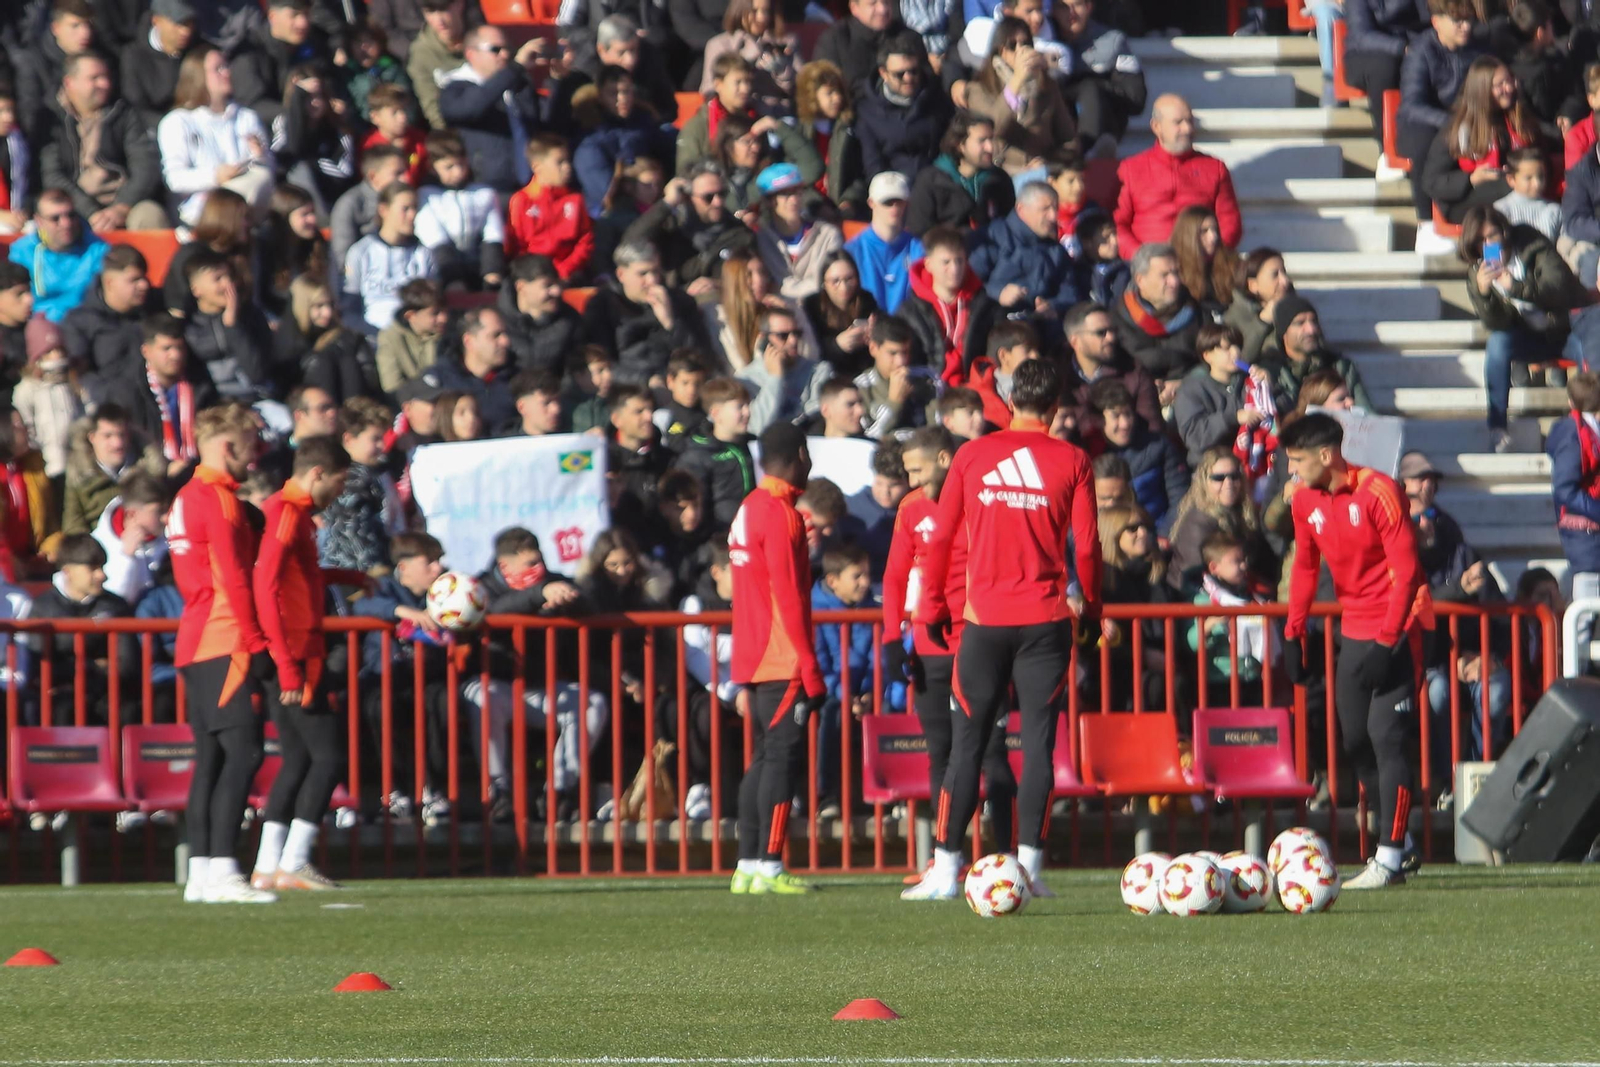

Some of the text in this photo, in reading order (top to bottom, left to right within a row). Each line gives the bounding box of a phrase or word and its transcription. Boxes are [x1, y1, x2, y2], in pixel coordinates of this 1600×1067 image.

[996, 490, 1048, 506] CAJA RURAL
[560, 534, 578, 556] 19
